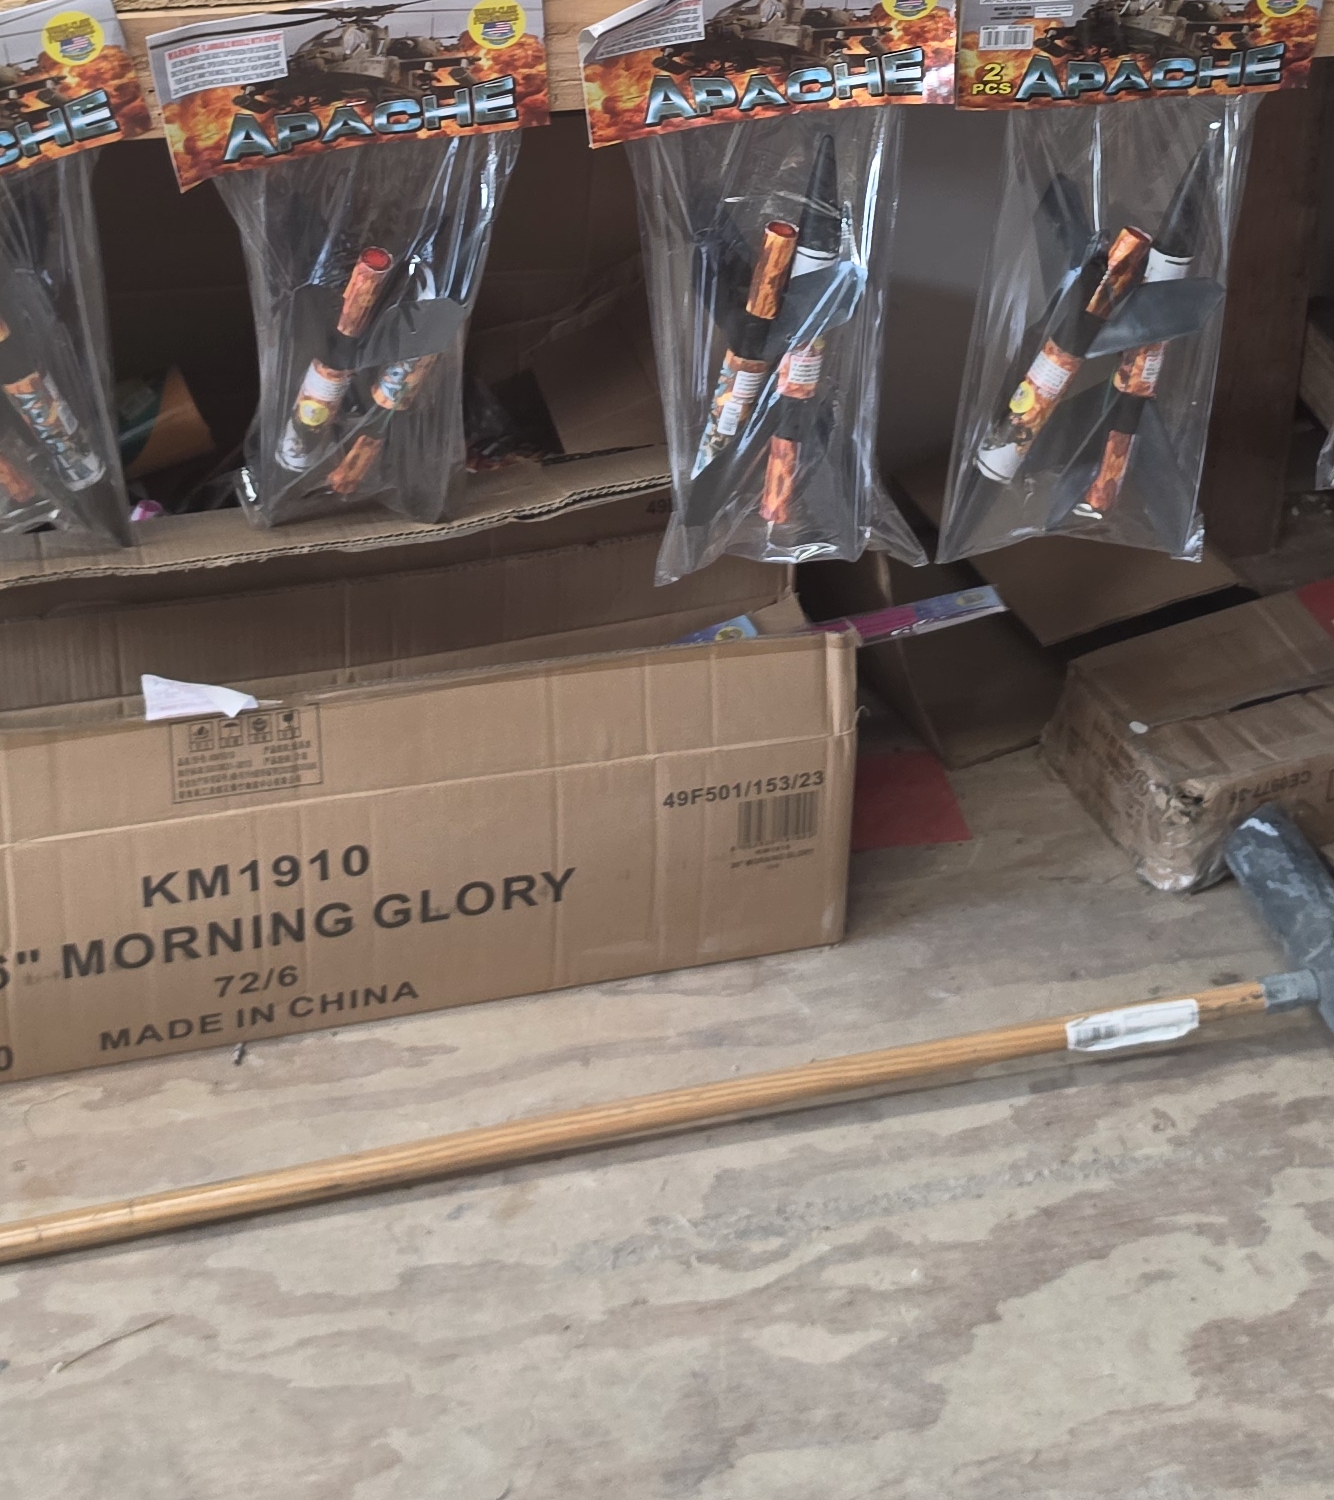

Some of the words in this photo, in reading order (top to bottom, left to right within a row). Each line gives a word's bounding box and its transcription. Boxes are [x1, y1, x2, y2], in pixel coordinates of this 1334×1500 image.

[644, 46, 925, 129] APACHE
[971, 79, 1013, 96] PCS
[982, 62, 1005, 82] 2
[1014, 42, 1286, 102] APACHE
[222, 75, 519, 164] APACHE
[662, 769, 825, 809] 49F501/153/23
[141, 842, 371, 910] KM1910
[63, 900, 356, 981] MORNING
[373, 865, 579, 931] GLORY
[214, 963, 300, 999] 72/6
[98, 1010, 224, 1053] MADE
[235, 1001, 277, 1029] IN
[287, 980, 421, 1021] CHINA
